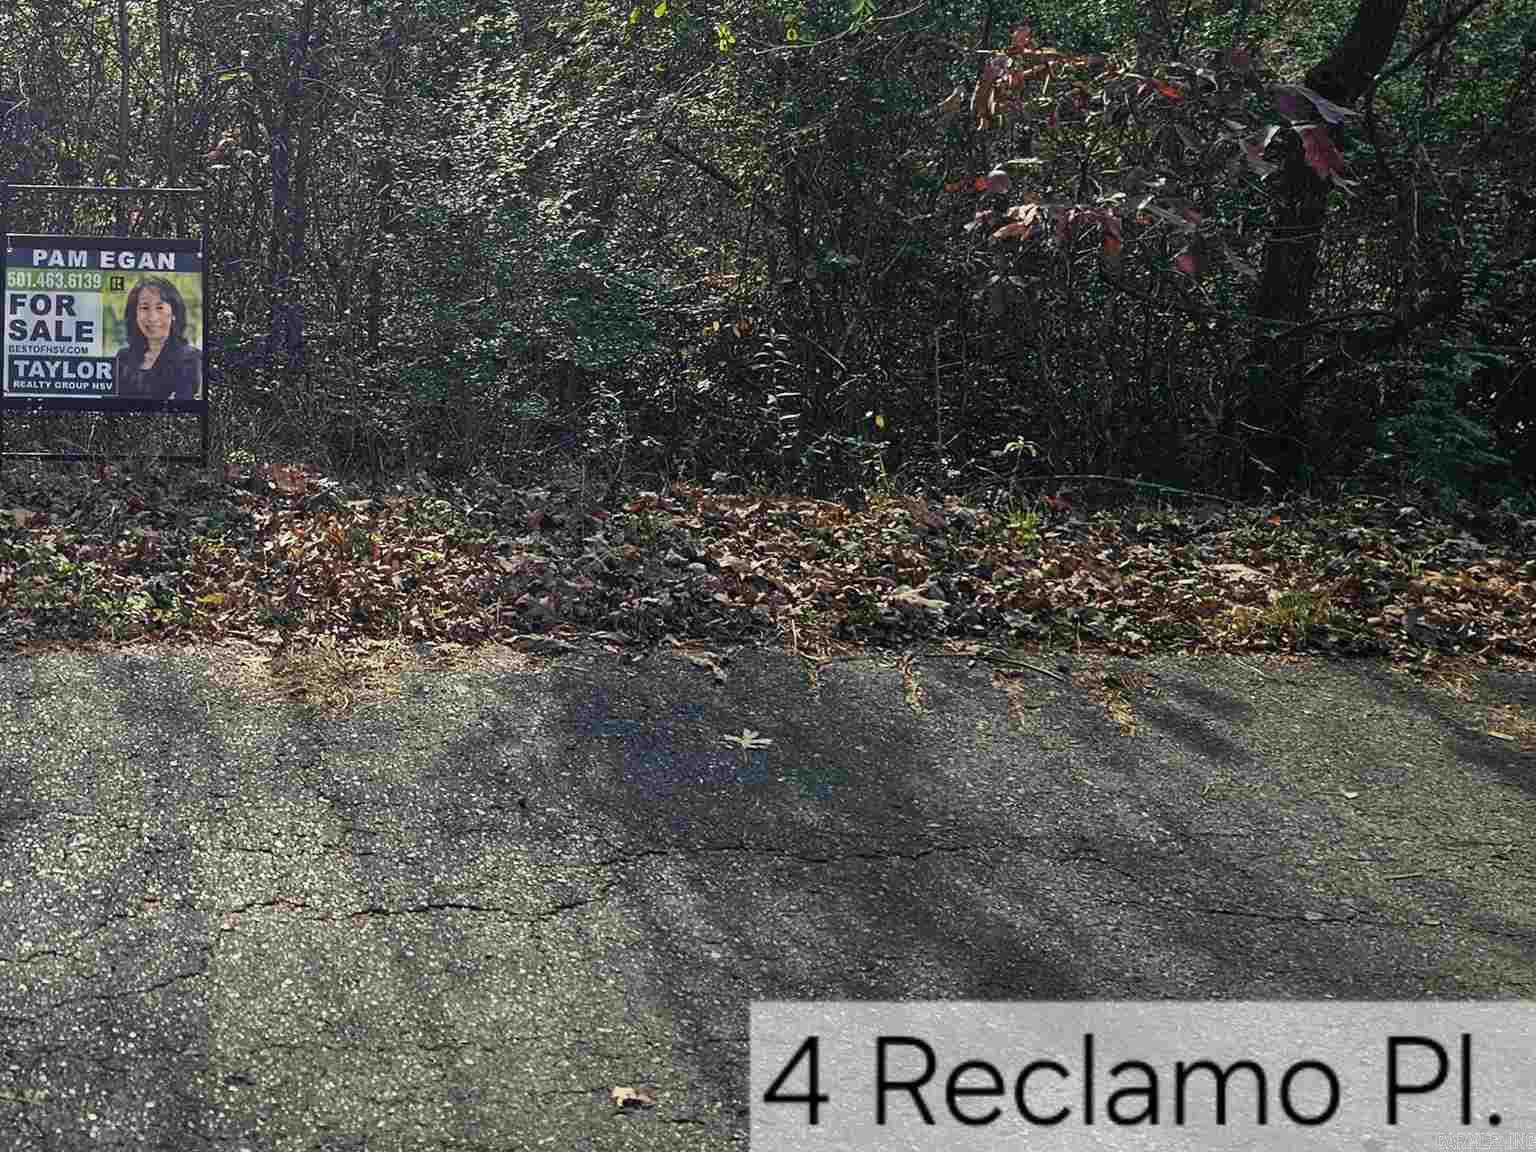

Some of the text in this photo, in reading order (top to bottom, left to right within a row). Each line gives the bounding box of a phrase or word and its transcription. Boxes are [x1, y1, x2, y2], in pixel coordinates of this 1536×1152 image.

[32, 249, 176, 270] PAM EGAN
[9, 294, 77, 316] FOR
[8, 319, 94, 343] SALE
[14, 359, 113, 379] TAYLOR
[14, 380, 113, 391] REALTY GROUP HSV
